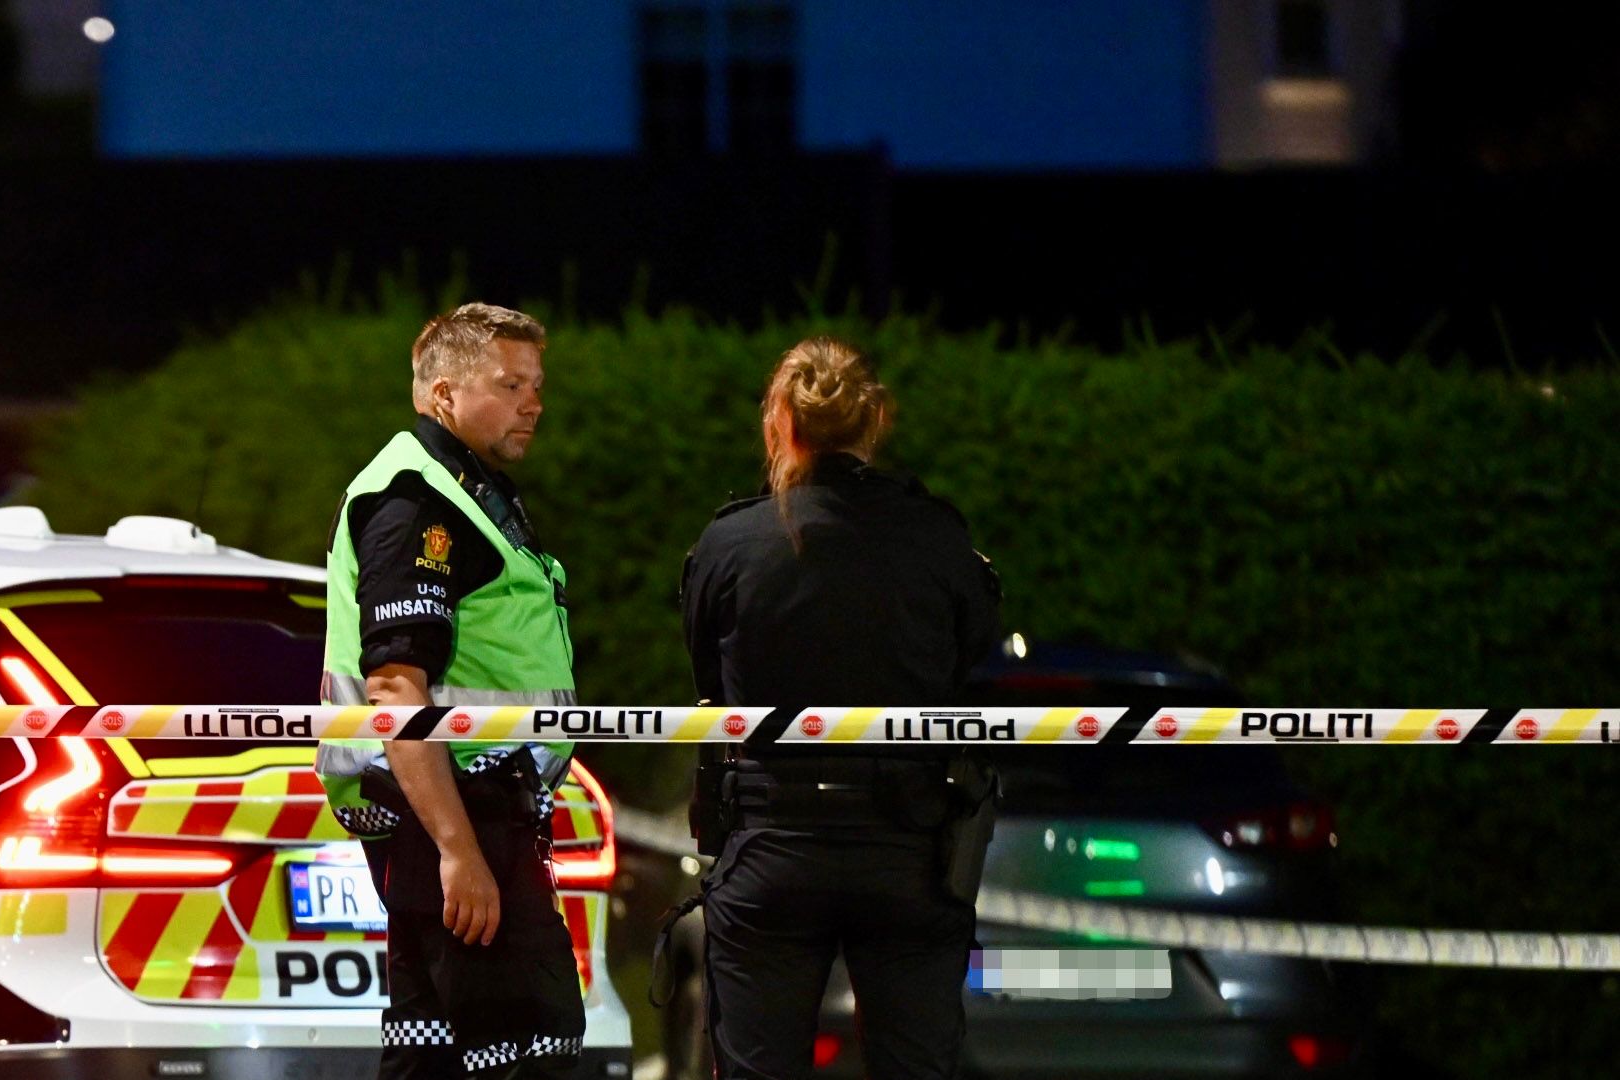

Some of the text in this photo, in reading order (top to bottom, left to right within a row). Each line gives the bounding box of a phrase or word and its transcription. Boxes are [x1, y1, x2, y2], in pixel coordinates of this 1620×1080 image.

[416, 557, 451, 575] POLITI
[417, 584, 447, 598] U-05
[25, 714, 47, 726] STOP
[183, 713, 313, 738] POLITI
[372, 717, 394, 728] STOP
[450, 717, 472, 729] STOP
[533, 710, 663, 734] POLITI
[724, 719, 747, 731] STOP
[801, 719, 823, 731] STOP
[1155, 720, 1178, 732] STOP
[1241, 712, 1373, 737] POLITI
[885, 718, 1016, 741] POLITI
[1436, 724, 1458, 735] STOP
